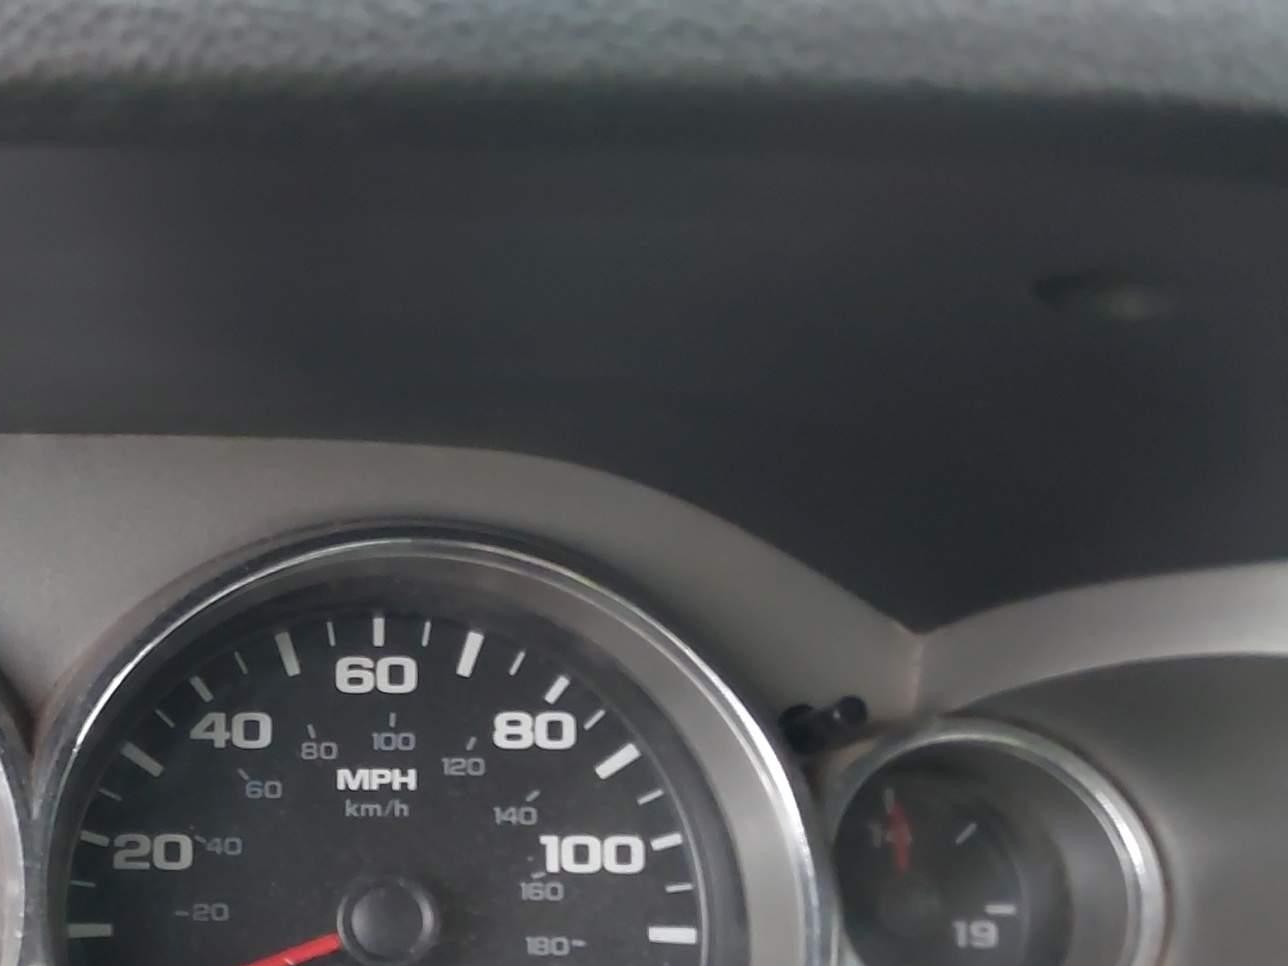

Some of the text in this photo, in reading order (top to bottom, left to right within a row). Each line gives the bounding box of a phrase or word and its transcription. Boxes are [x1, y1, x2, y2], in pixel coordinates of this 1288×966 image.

[336, 657, 417, 693] 60
[193, 713, 272, 748] 40
[493, 712, 576, 749] 80
[301, 742, 337, 759] 80
[373, 733, 415, 750] 100
[442, 758, 485, 775] 120
[337, 769, 416, 790] MPH
[244, 781, 282, 798] 60
[346, 800, 408, 816] km/h
[494, 807, 537, 825] 140
[116, 834, 192, 870] 20
[207, 838, 242, 855] 40
[540, 836, 644, 872] 100
[521, 882, 563, 900] 160
[193, 903, 229, 921] 20
[956, 921, 998, 947] 19
[526, 937, 569, 955] 180
